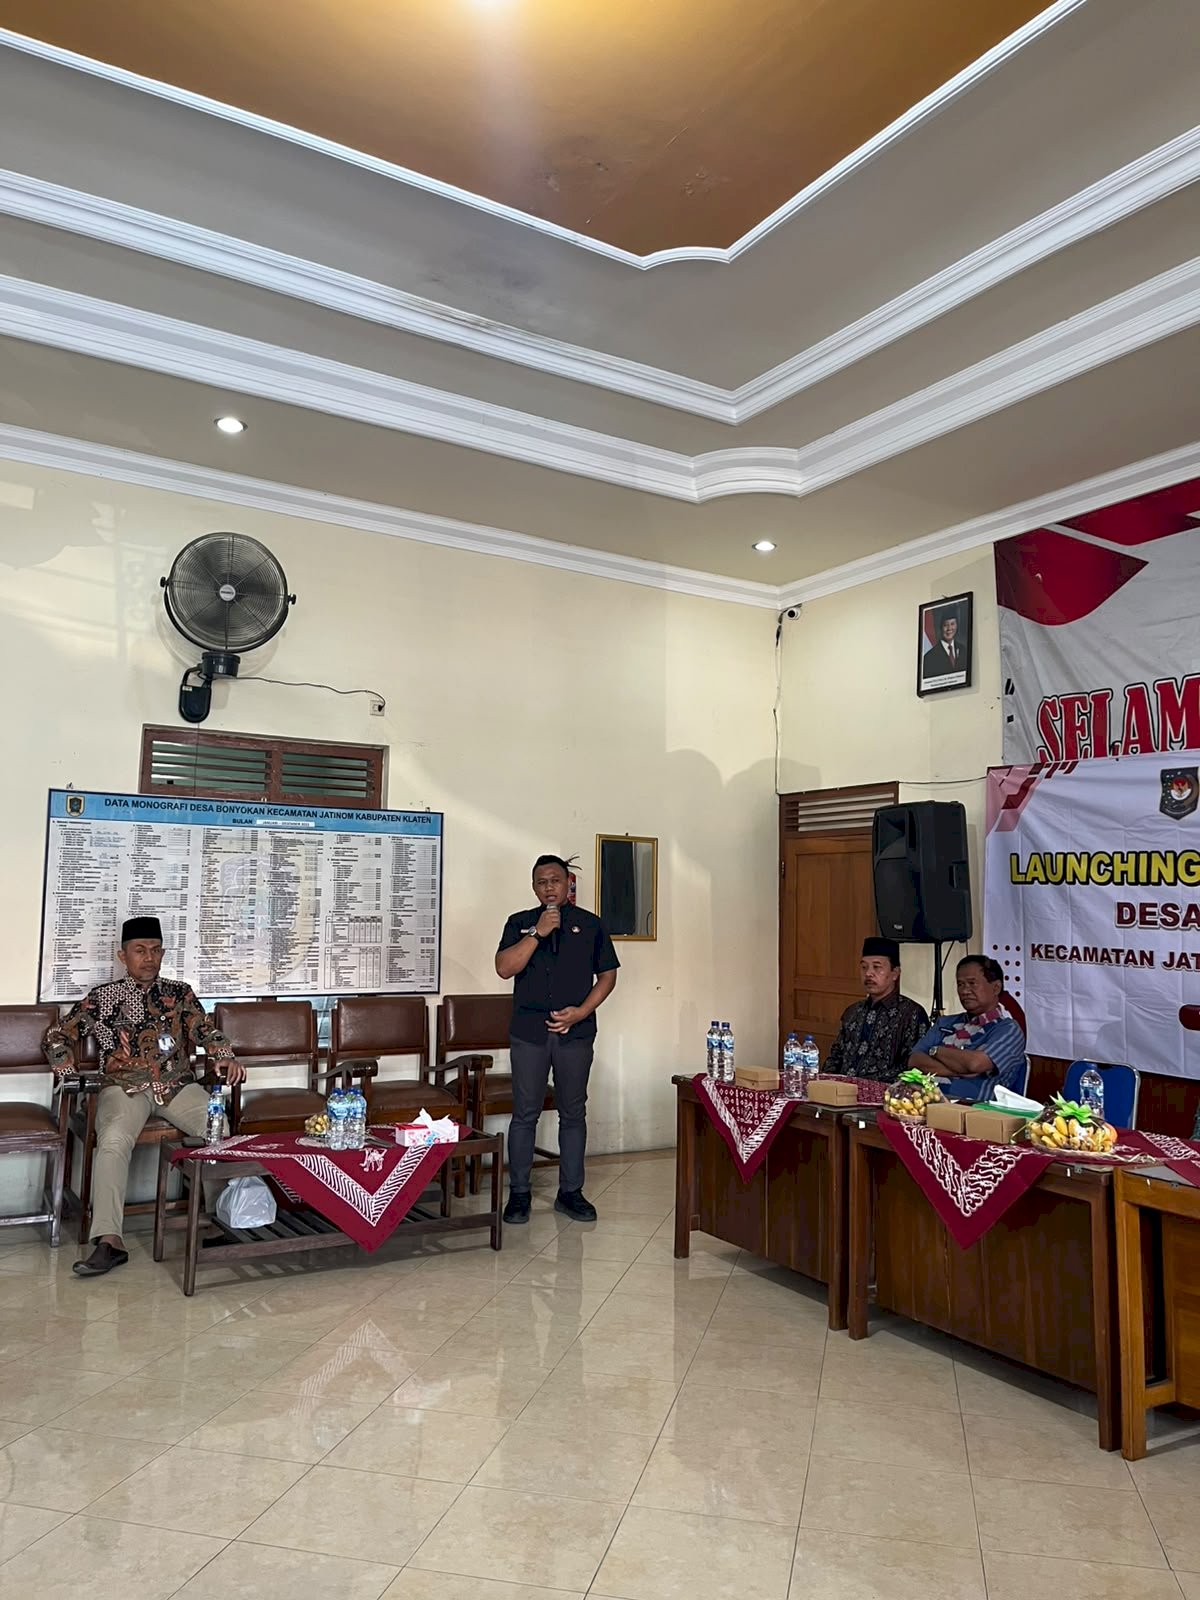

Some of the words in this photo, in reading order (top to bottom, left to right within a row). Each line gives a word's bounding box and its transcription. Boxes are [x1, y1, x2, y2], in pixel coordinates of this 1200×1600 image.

[104, 798, 130, 808] DATA
[131, 800, 188, 811] MONOGRAFI
[189, 803, 214, 812] DESA
[216, 805, 265, 815] BONYOKAN
[267, 807, 318, 818] KECAMATAN
[319, 811, 354, 819] JATINOM
[356, 814, 401, 822] KABUPATEN
[402, 816, 432, 824] KLATEN
[1010, 849, 1200, 887] LAUNCHING
[1115, 901, 1200, 930] DESA
[1030, 943, 1155, 968] KECAMATAN
